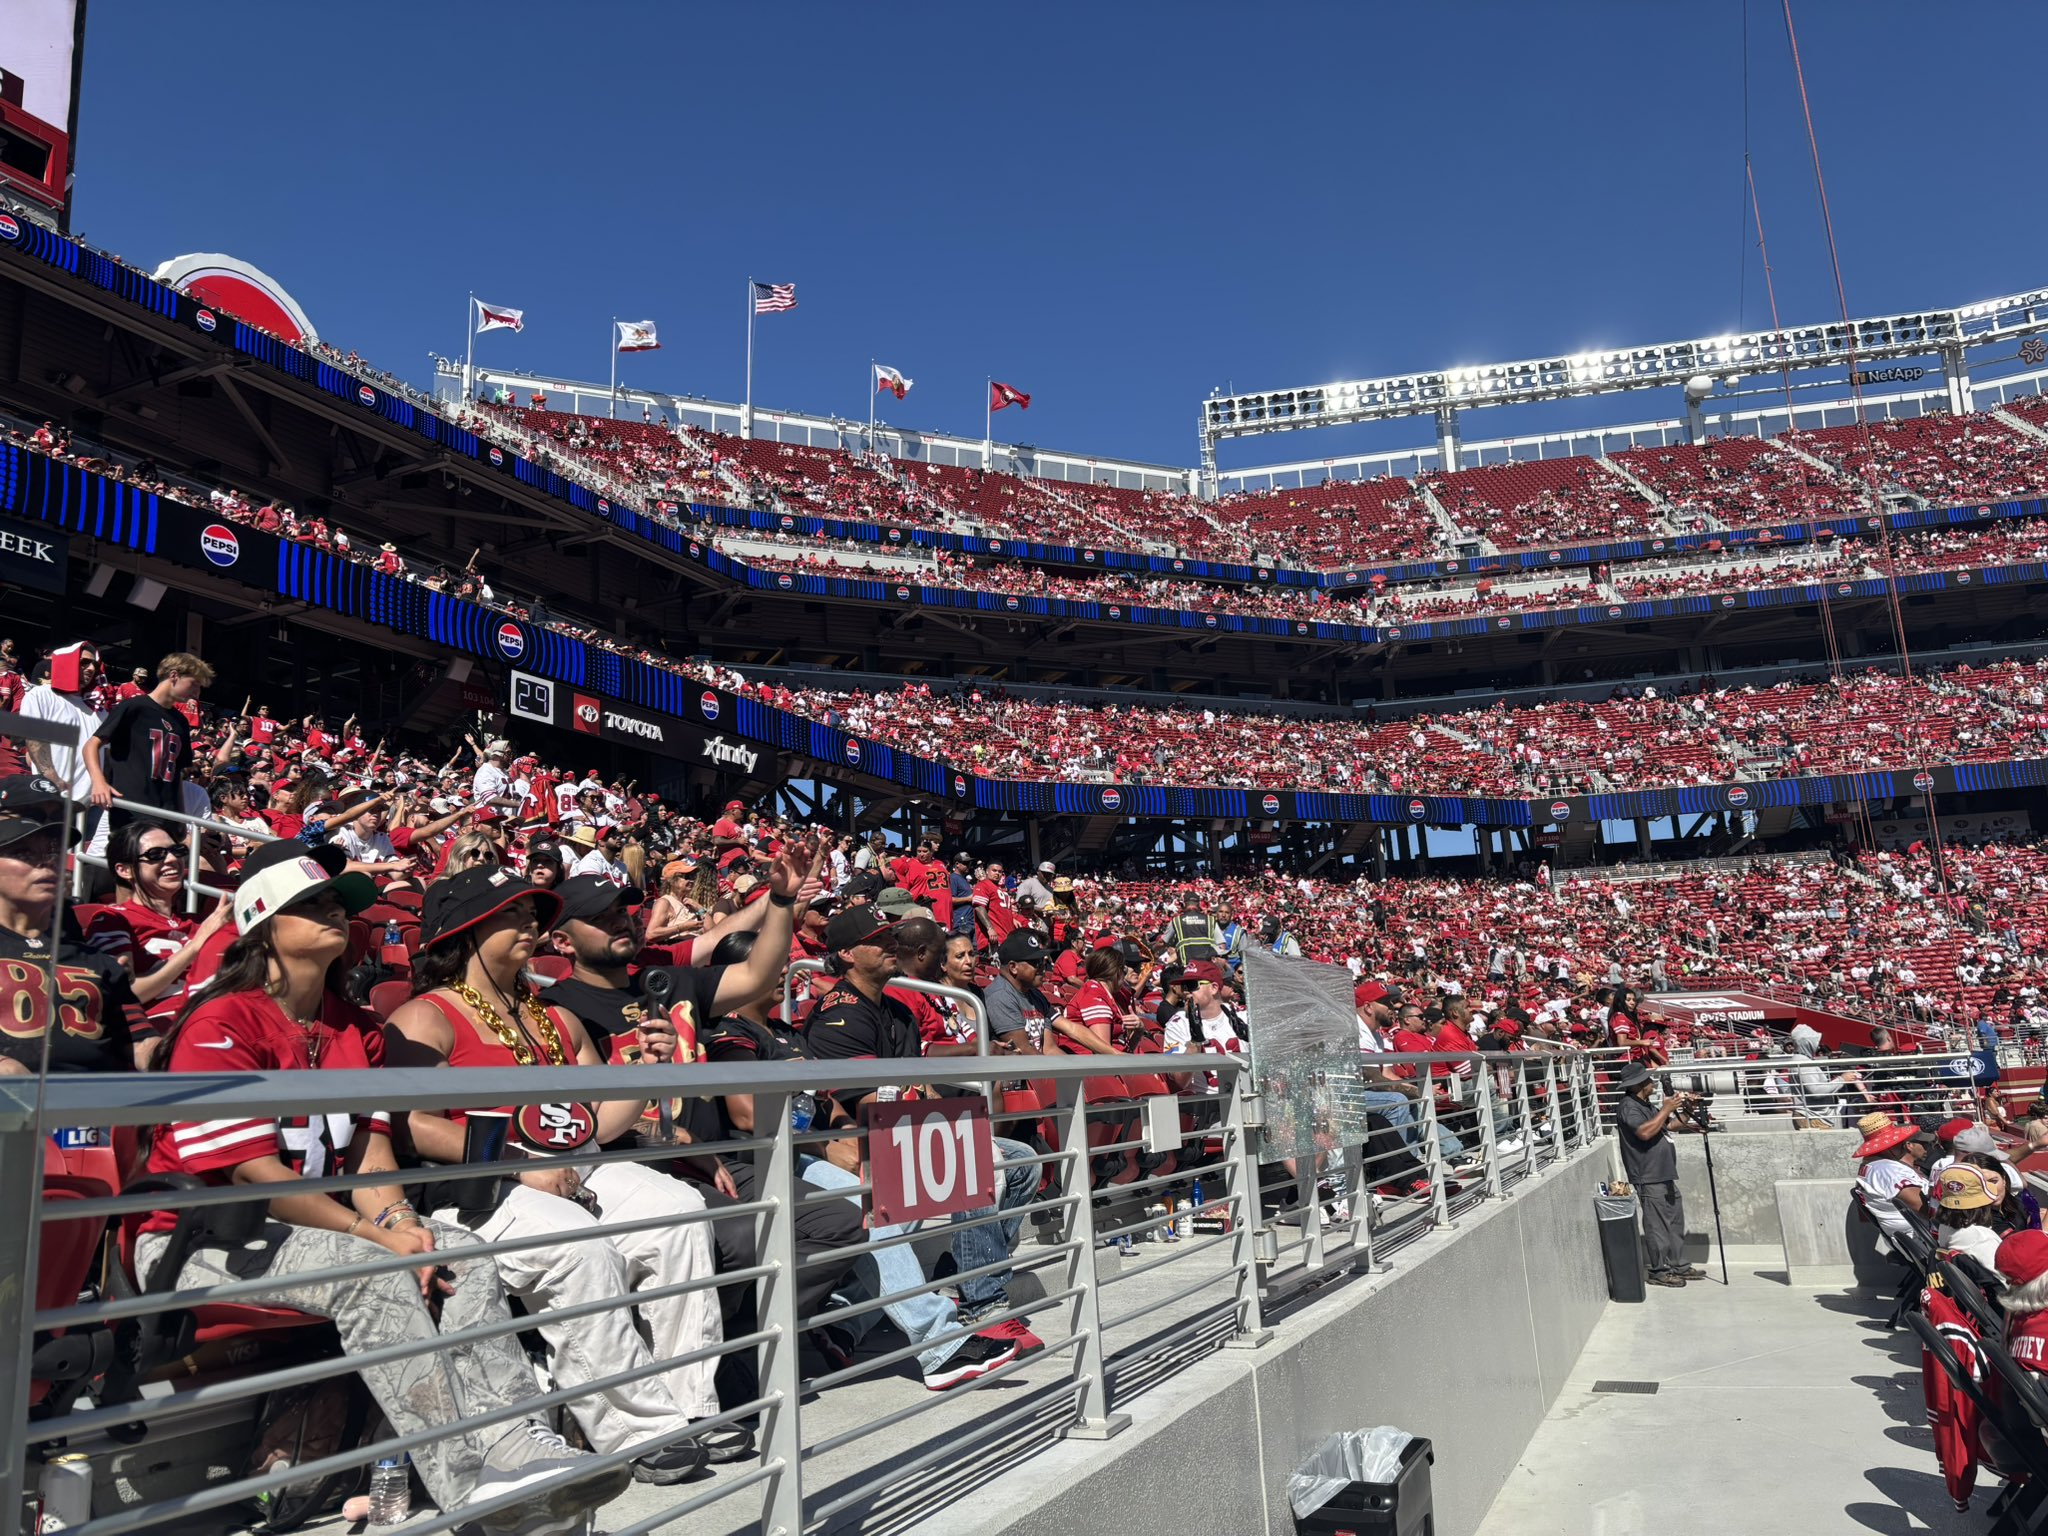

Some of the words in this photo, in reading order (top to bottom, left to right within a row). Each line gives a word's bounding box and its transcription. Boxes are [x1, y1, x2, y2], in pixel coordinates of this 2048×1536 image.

[1868, 368, 1923, 381] NetApp
[203, 536, 237, 555] PEPSI
[500, 633, 522, 648] PEPSI
[519, 681, 547, 713] 29
[702, 699, 718, 710] PEPSI
[605, 711, 663, 742] TOYOTA
[148, 728, 182, 783] 18
[702, 735, 758, 774] xfinity
[847, 747, 859, 756] PEPSI
[925, 871, 949, 890] 23
[0, 958, 104, 1041] 85
[1728, 1010, 1765, 1020] STADIUM
[540, 1103, 586, 1144] SF
[892, 1109, 979, 1208] 101
